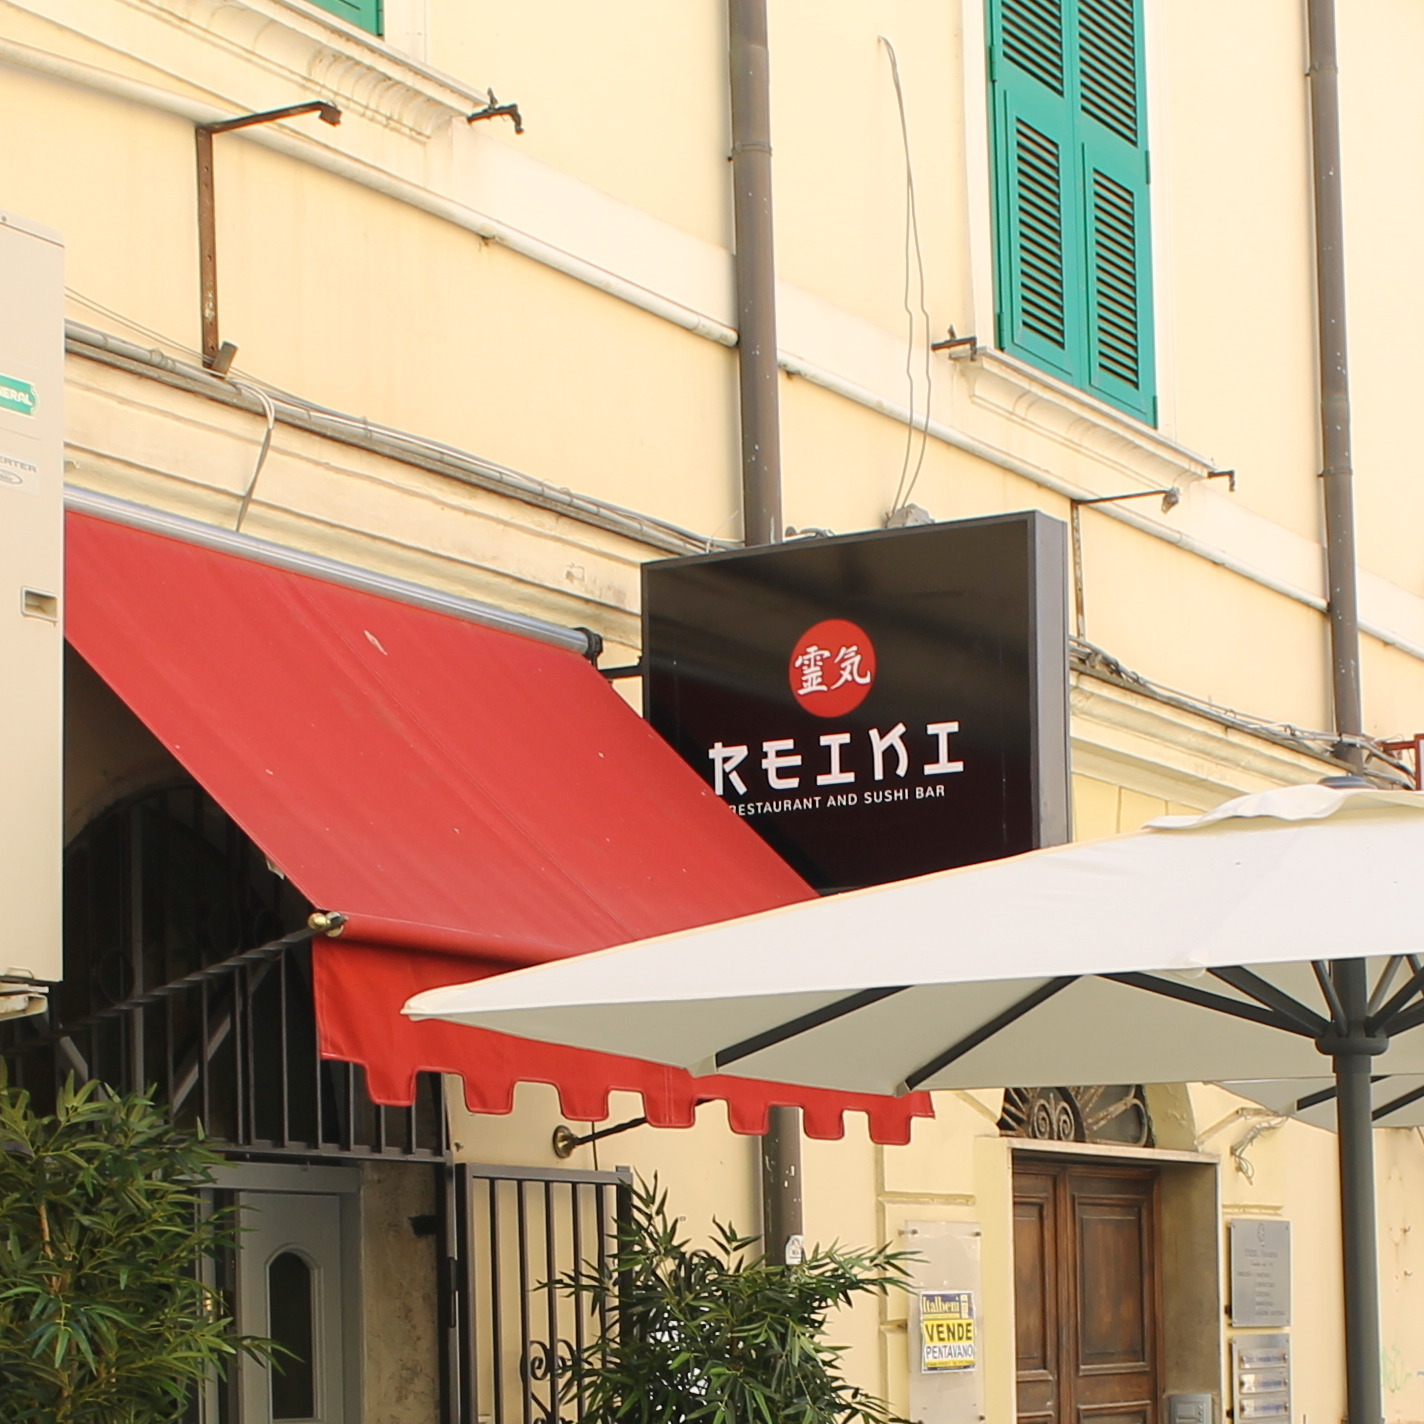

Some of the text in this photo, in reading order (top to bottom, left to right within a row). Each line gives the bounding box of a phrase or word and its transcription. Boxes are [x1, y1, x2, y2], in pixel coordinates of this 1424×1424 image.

[708, 721, 964, 796] REIKI
[826, 793, 858, 808] AND
[864, 789, 909, 804] SUSHI
[915, 784, 945, 799] BAR
[925, 1322, 972, 1342] VENDE
